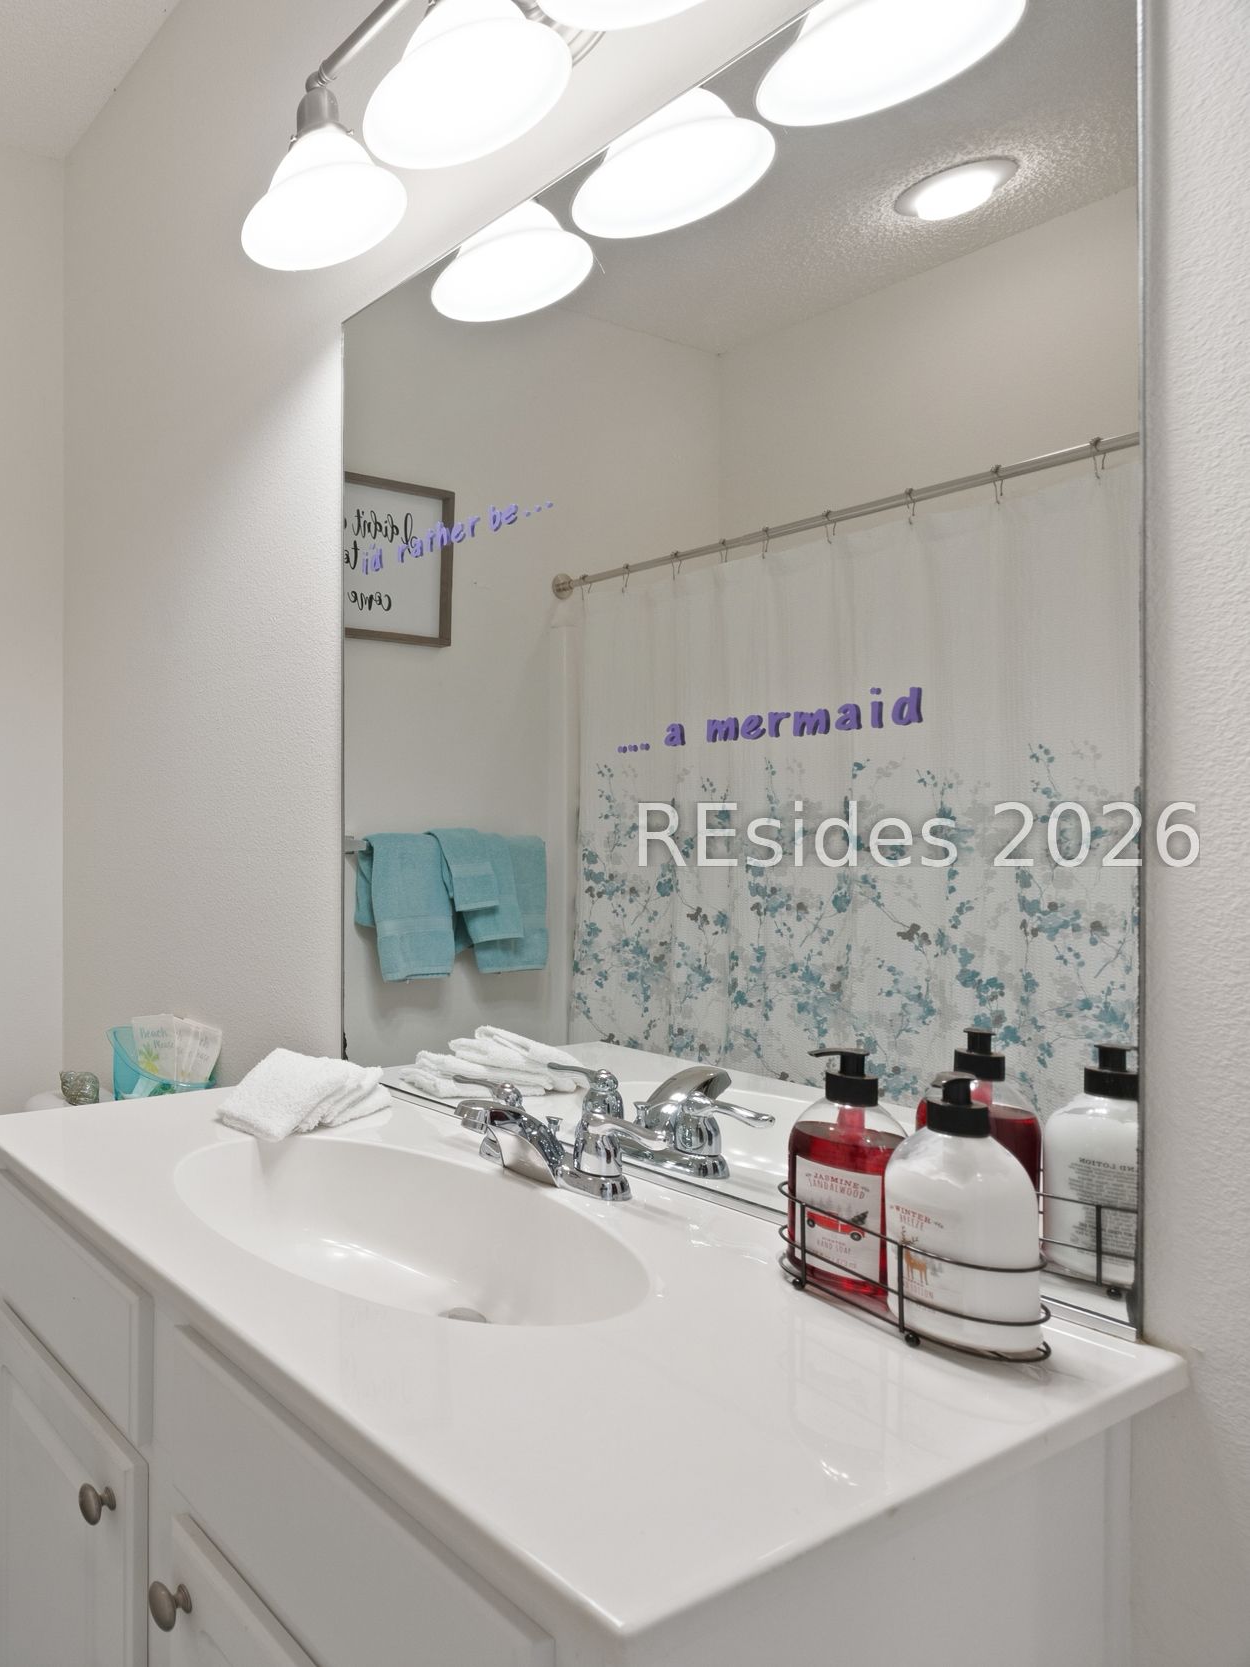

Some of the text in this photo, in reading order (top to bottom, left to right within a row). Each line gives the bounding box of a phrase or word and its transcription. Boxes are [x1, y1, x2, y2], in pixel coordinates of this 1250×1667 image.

[664, 722, 686, 747] a
[706, 686, 923, 743] mermaid
[808, 1178, 866, 1200] SANDALWOOD
[813, 1172, 860, 1190] JASMINE
